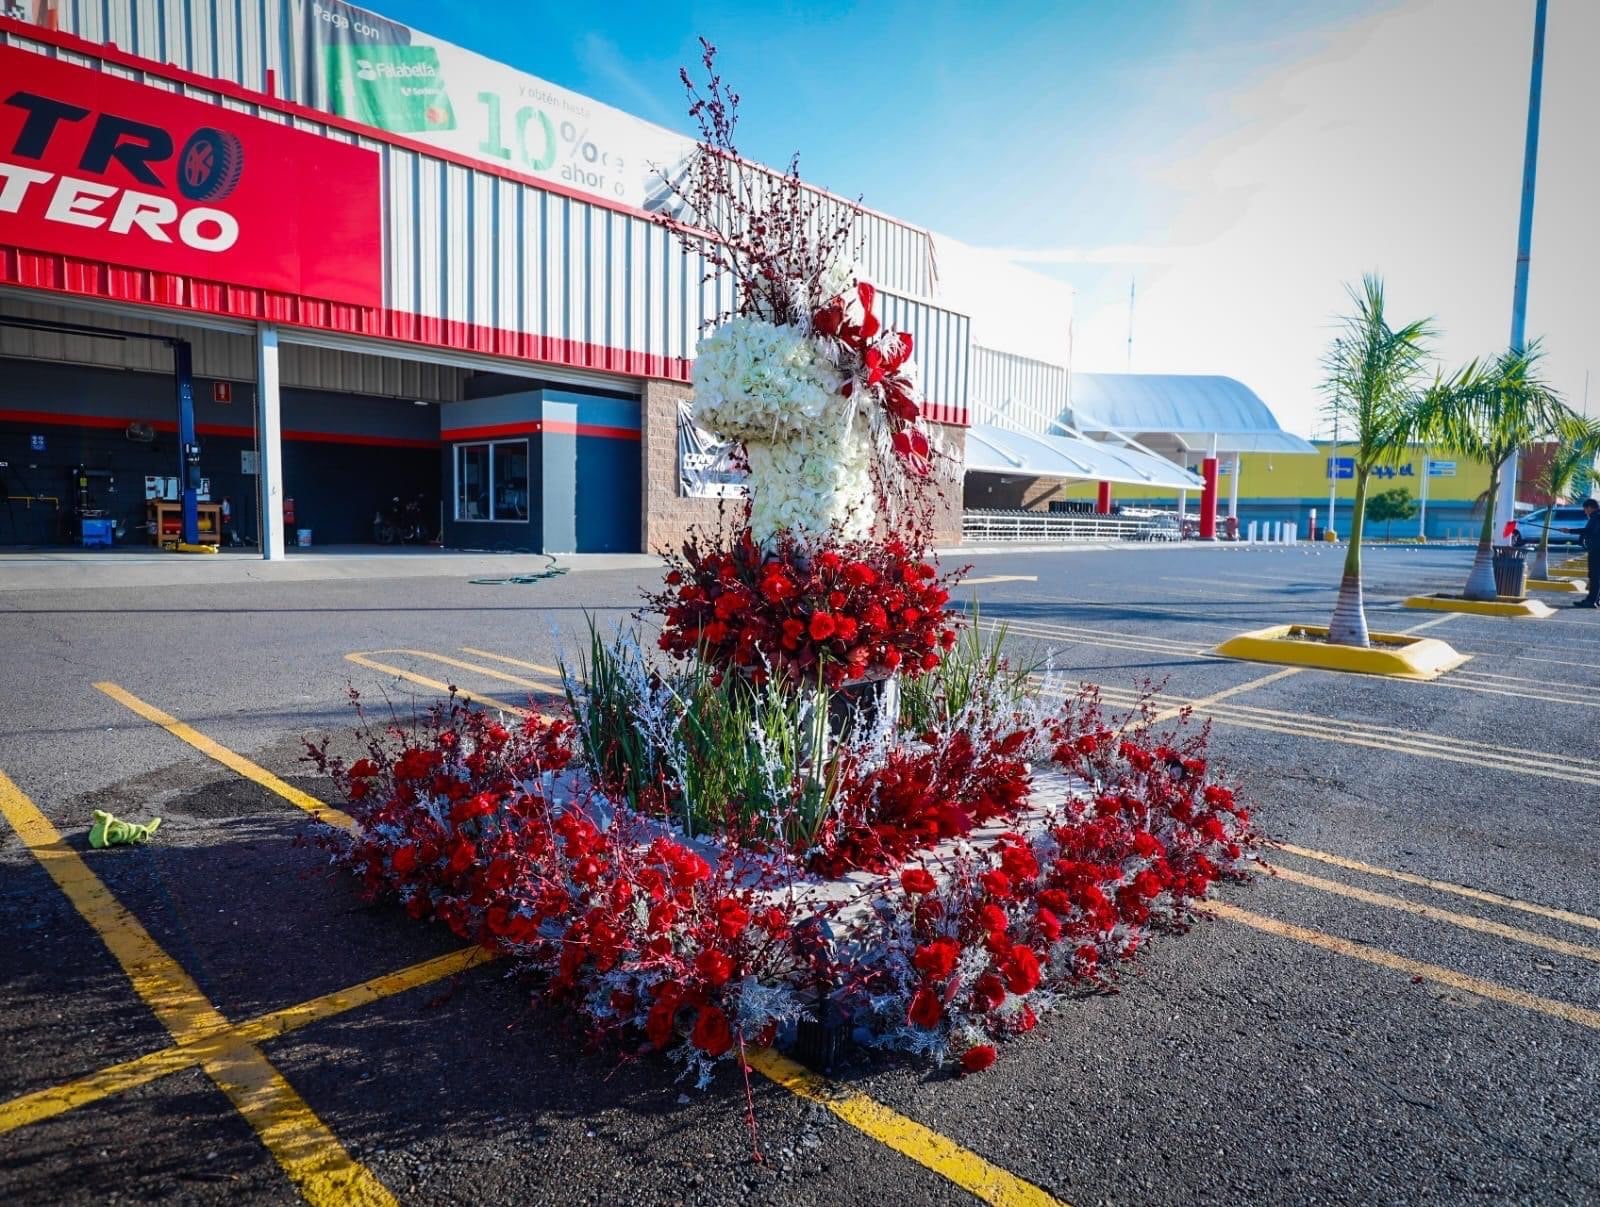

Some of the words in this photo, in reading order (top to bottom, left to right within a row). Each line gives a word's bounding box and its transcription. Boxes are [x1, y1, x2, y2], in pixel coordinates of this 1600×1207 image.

[312, 3, 350, 30] Paga
[353, 22, 380, 41] con
[376, 62, 436, 78] Falabella
[519, 85, 526, 97] y
[560, 162, 626, 197] ahoro
[0, 162, 240, 253] TERO
